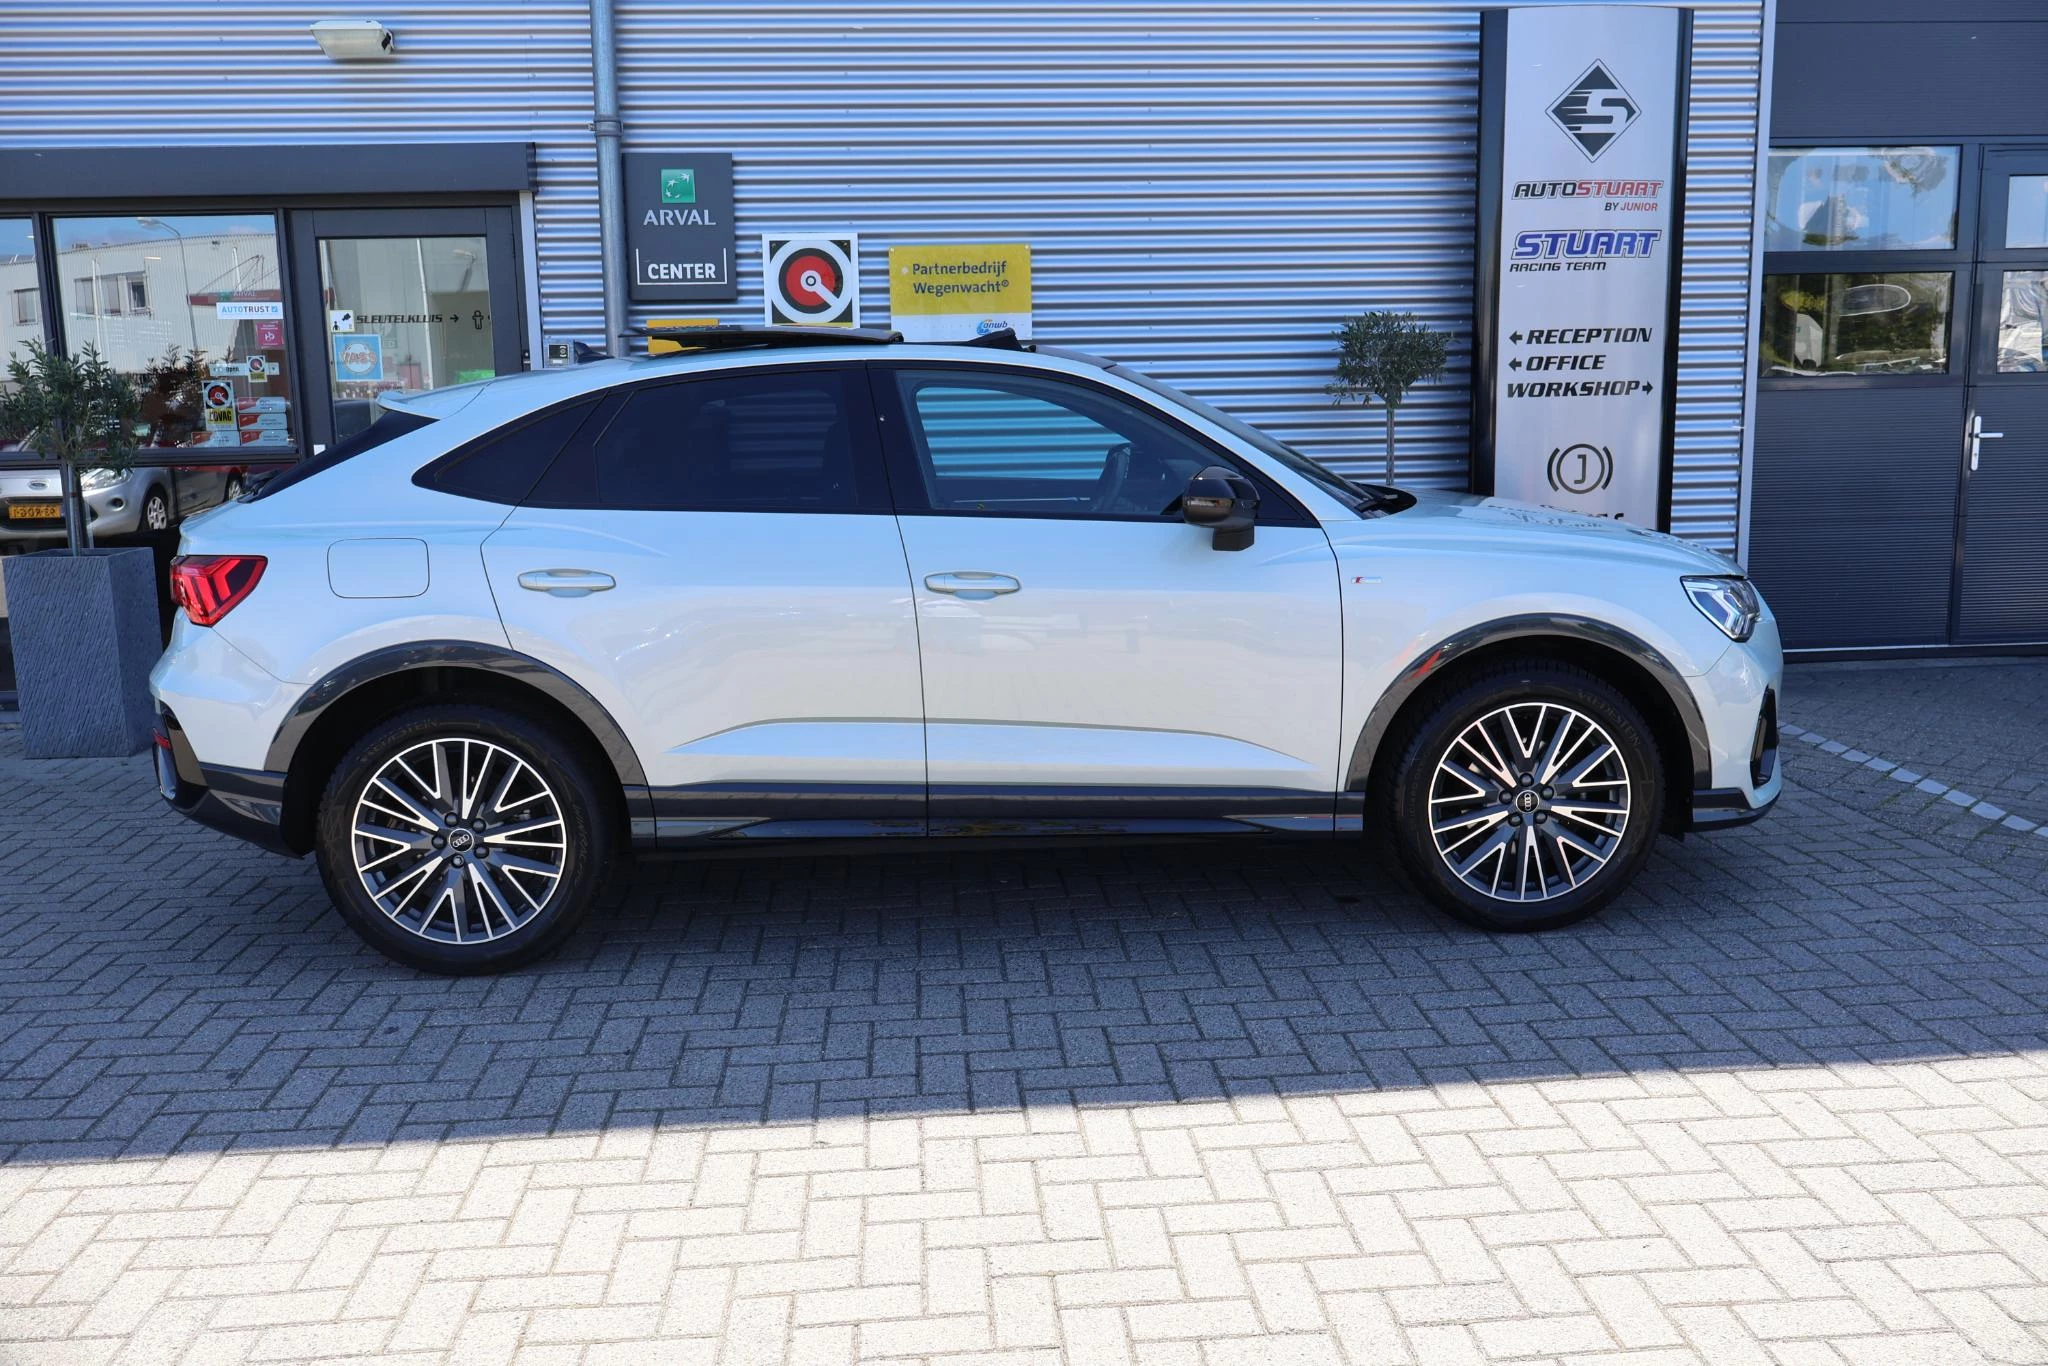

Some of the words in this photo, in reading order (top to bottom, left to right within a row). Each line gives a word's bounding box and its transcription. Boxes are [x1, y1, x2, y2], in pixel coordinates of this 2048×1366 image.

[1513, 181, 1663, 198] AUTOSTUART
[1605, 202, 1619, 211] BY
[1621, 202, 1657, 211] JUNIOR
[643, 209, 717, 226] ARVAL
[1512, 230, 1661, 259] STUART
[647, 263, 716, 279] CENTER
[912, 261, 1007, 277] Partnerbedrijf
[1509, 262, 1560, 272] RACING
[1566, 261, 1606, 271] TEAM
[221, 305, 270, 313] AUTOTRUST
[356, 314, 443, 324] SLEUTELKLUIS
[983, 320, 1008, 329] anwb
[1526, 327, 1653, 344] RECEPTION
[1526, 355, 1606, 371] OFFICE
[1507, 380, 1640, 398] WORKSHOP
